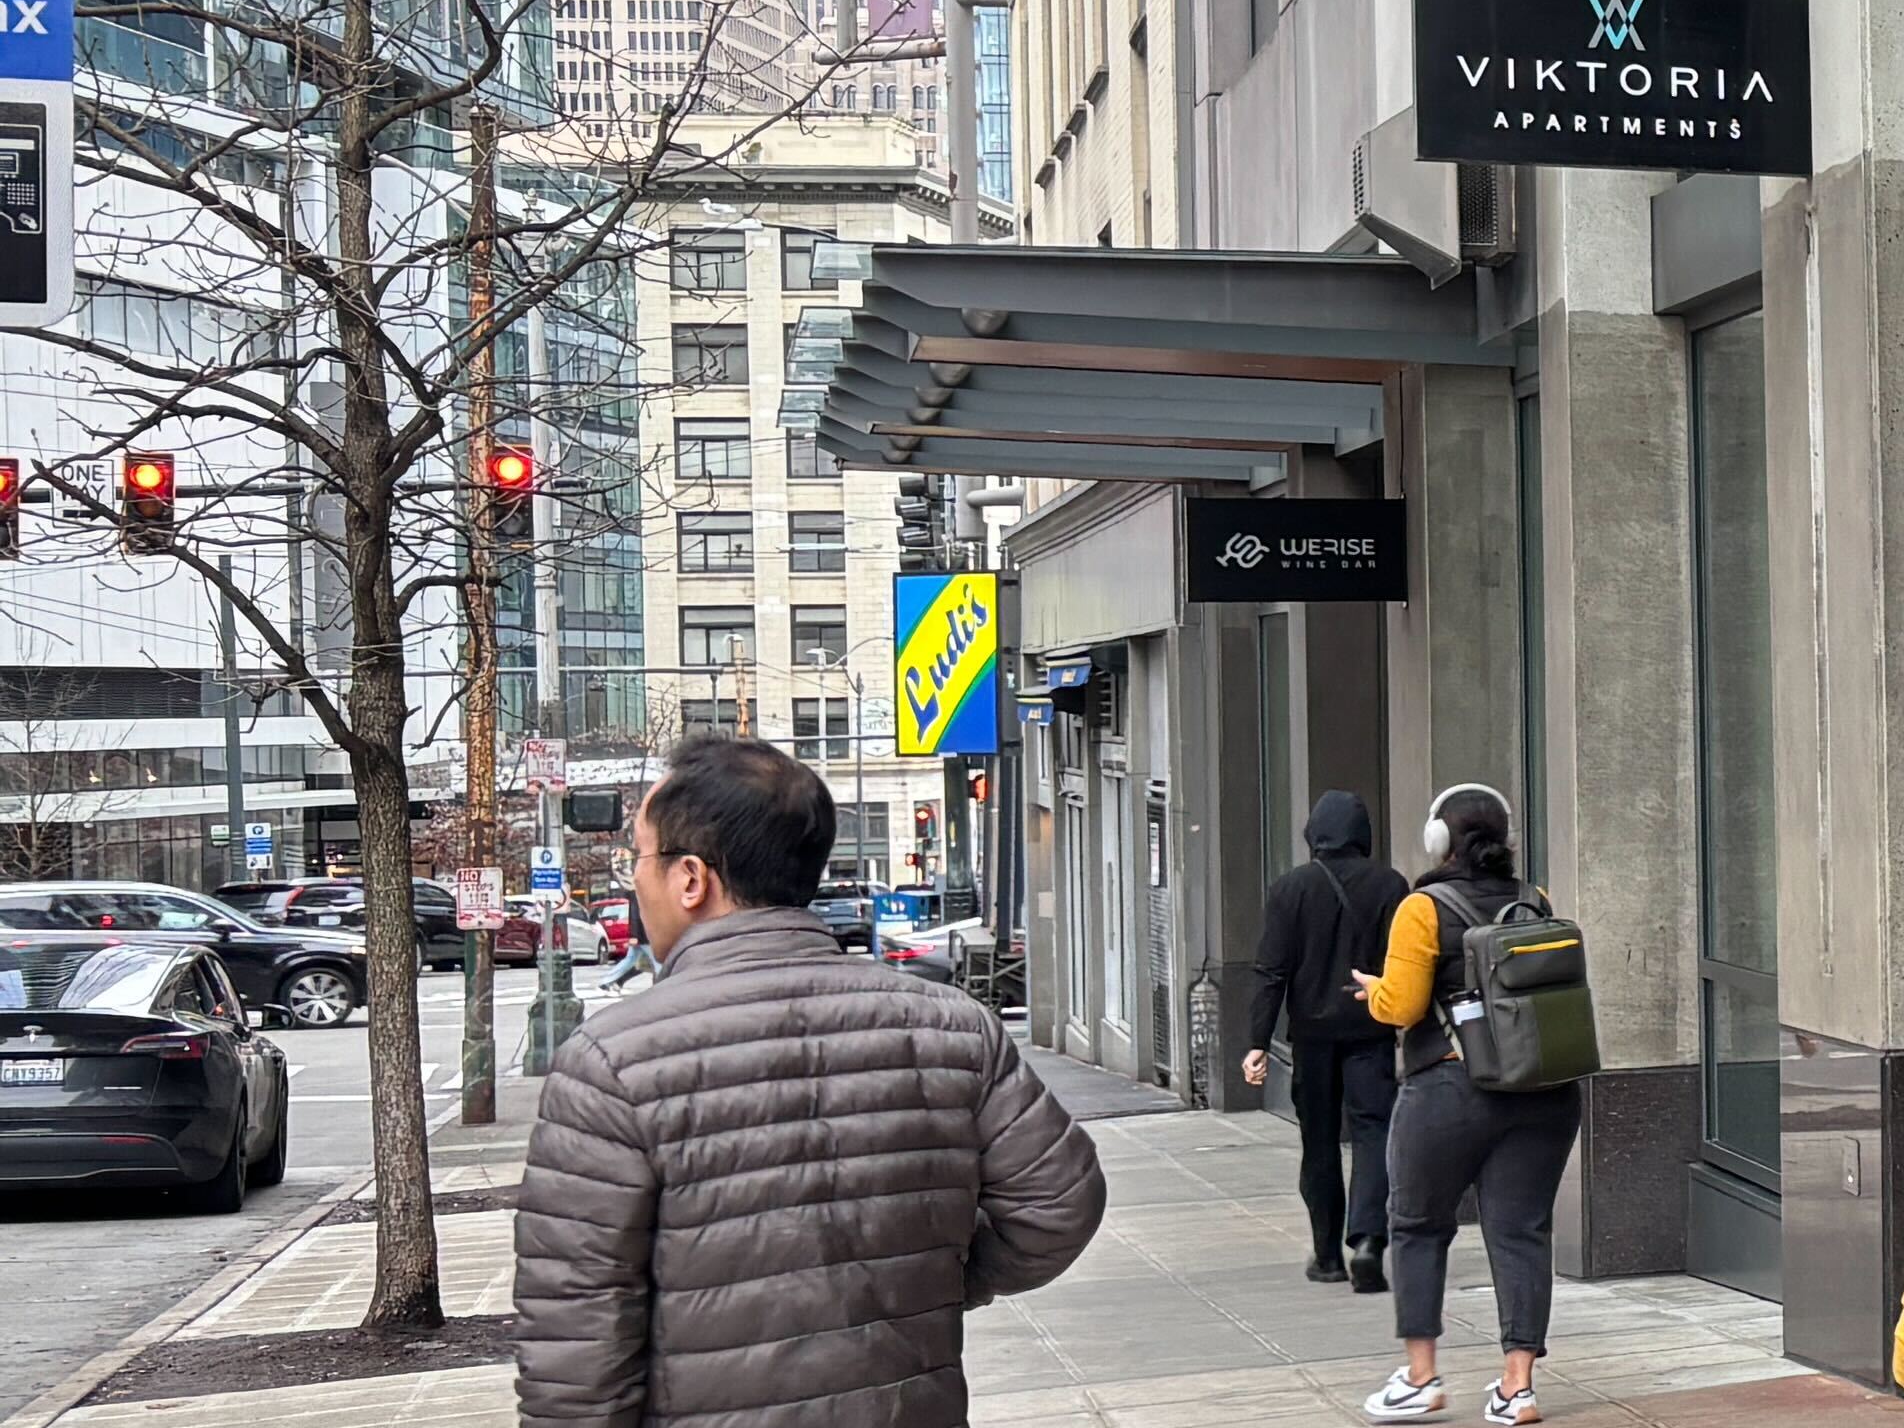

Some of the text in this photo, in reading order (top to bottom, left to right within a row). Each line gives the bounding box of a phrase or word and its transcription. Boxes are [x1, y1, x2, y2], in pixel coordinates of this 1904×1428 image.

[1456, 54, 1774, 103] VIKTORIA
[1493, 111, 1742, 140] APARTMENTS
[61, 464, 106, 481] ONE
[1280, 538, 1376, 556] WERISE
[1281, 559, 1376, 569] WINE BAR
[904, 583, 987, 746] Ludi's
[460, 871, 479, 881] NO
